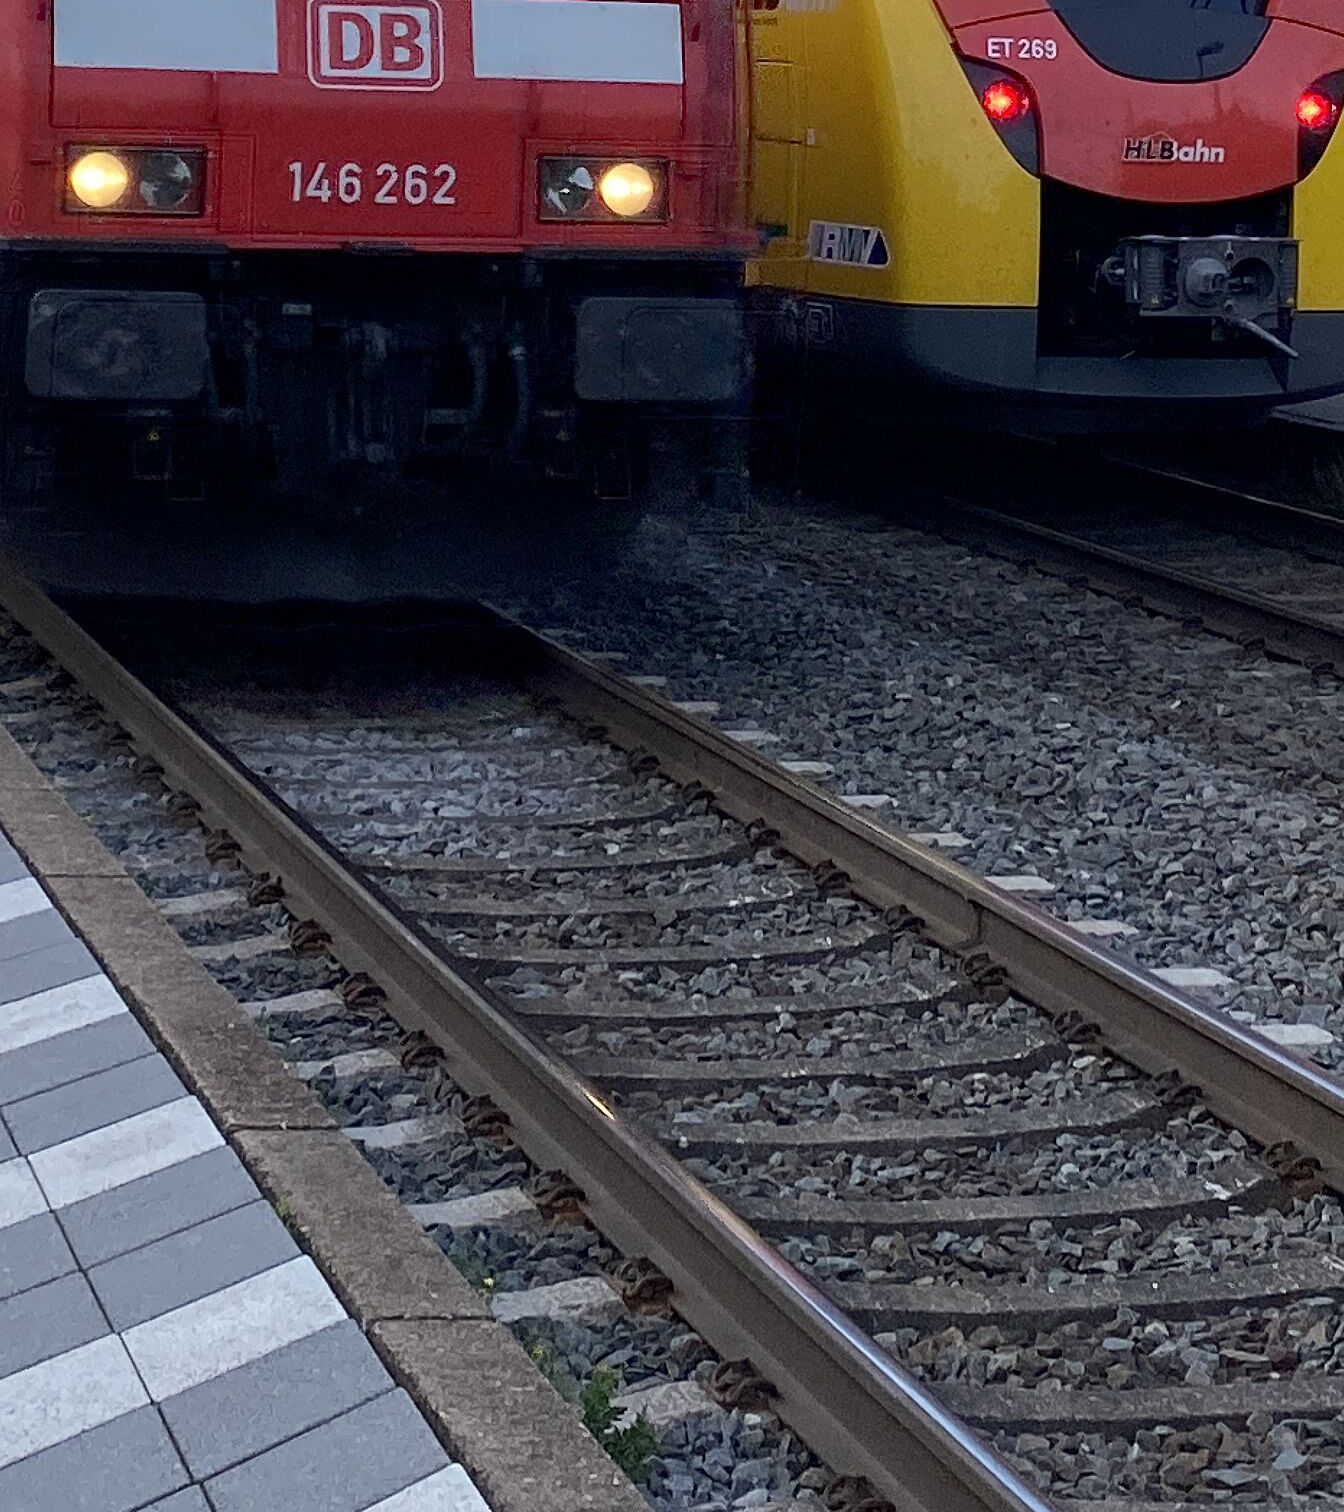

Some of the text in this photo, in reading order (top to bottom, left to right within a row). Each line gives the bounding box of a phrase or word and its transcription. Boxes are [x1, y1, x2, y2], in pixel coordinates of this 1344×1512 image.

[327, 11, 425, 71] DB
[987, 38, 1058, 60] ET 269
[288, 160, 457, 205] 146 262
